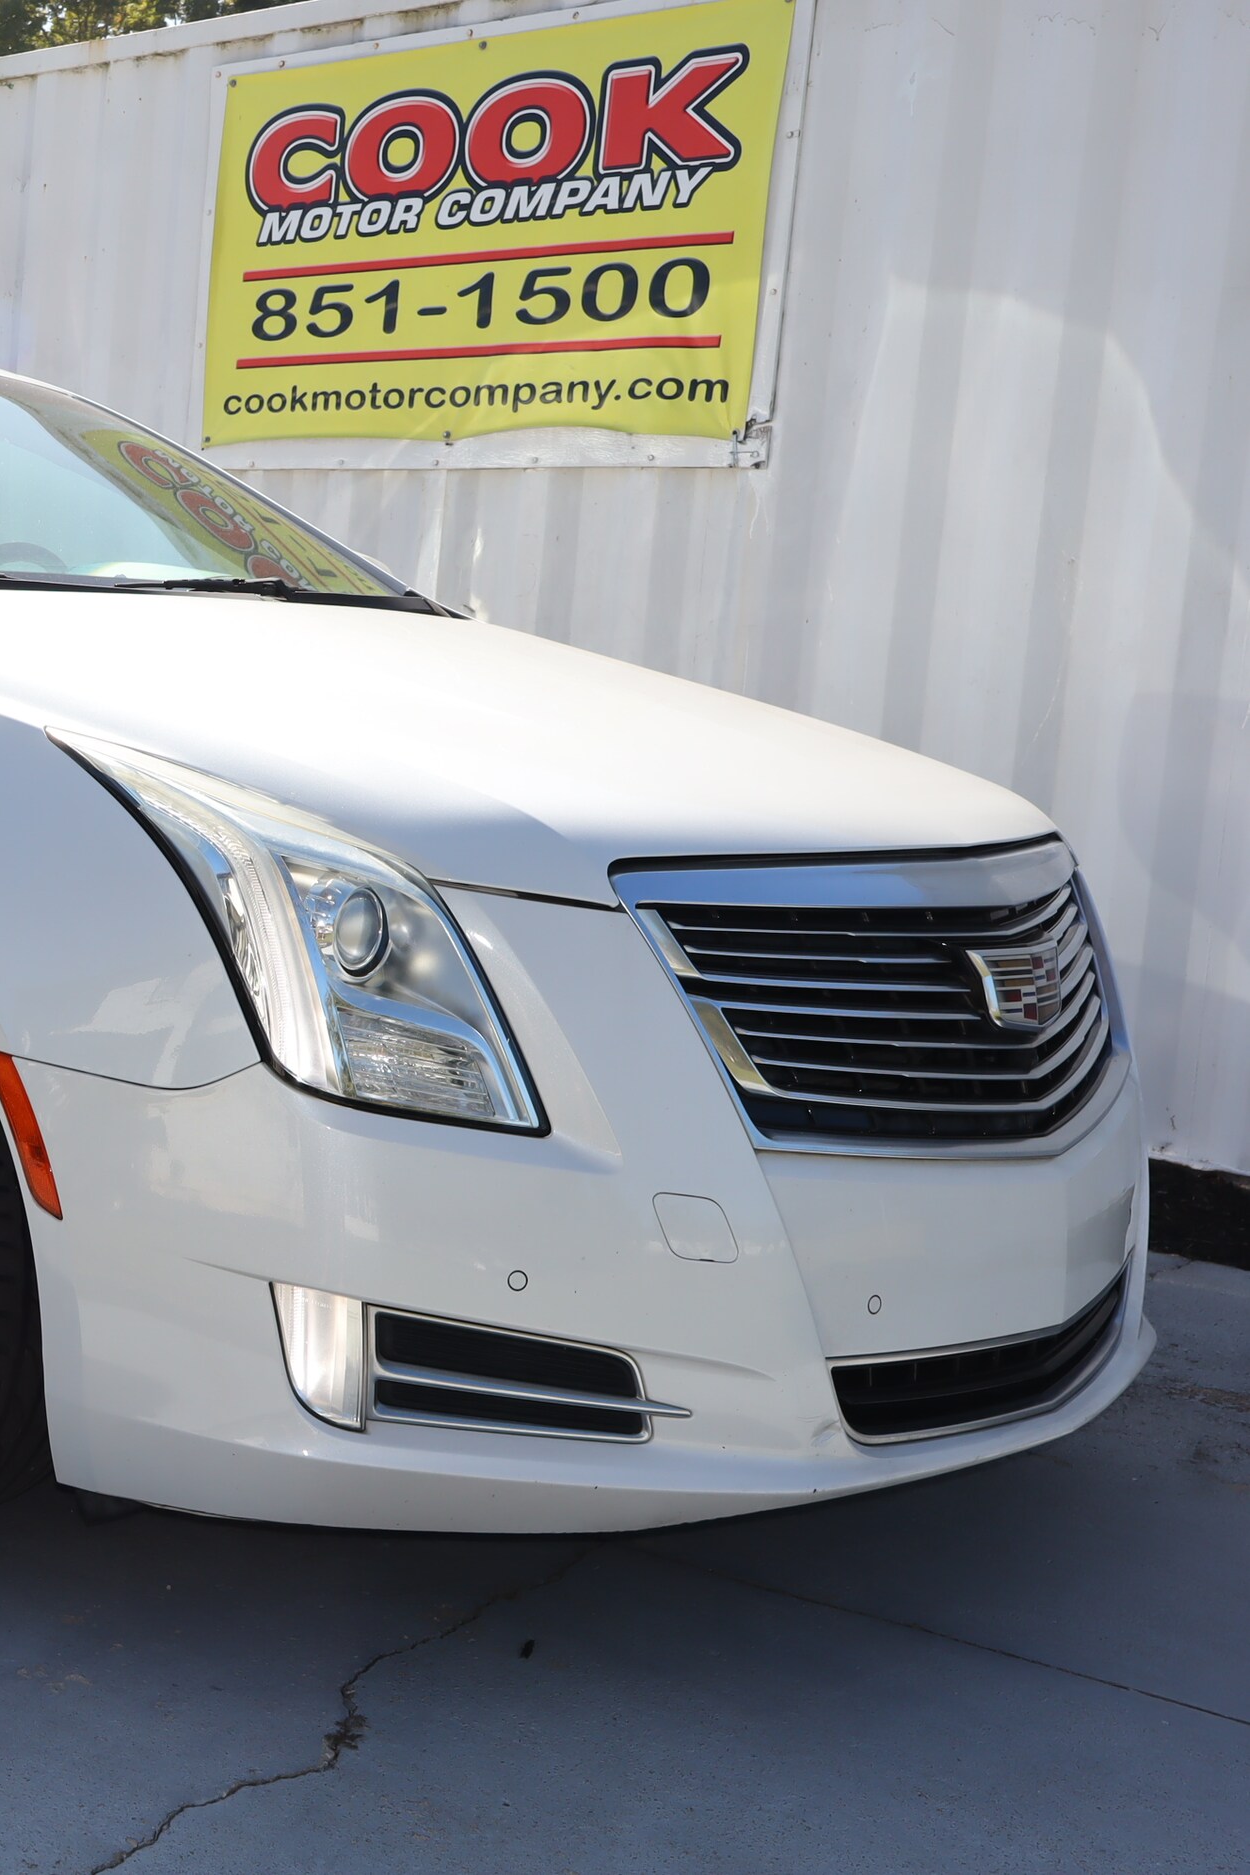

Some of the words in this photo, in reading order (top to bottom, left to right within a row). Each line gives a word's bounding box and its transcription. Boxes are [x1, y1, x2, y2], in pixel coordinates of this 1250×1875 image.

[247, 45, 748, 211] COOK
[257, 197, 425, 246] MOTOR
[436, 167, 712, 228] COMPANY
[252, 258, 710, 341] 851-1500
[223, 374, 729, 415] cookmotorcompany.com
